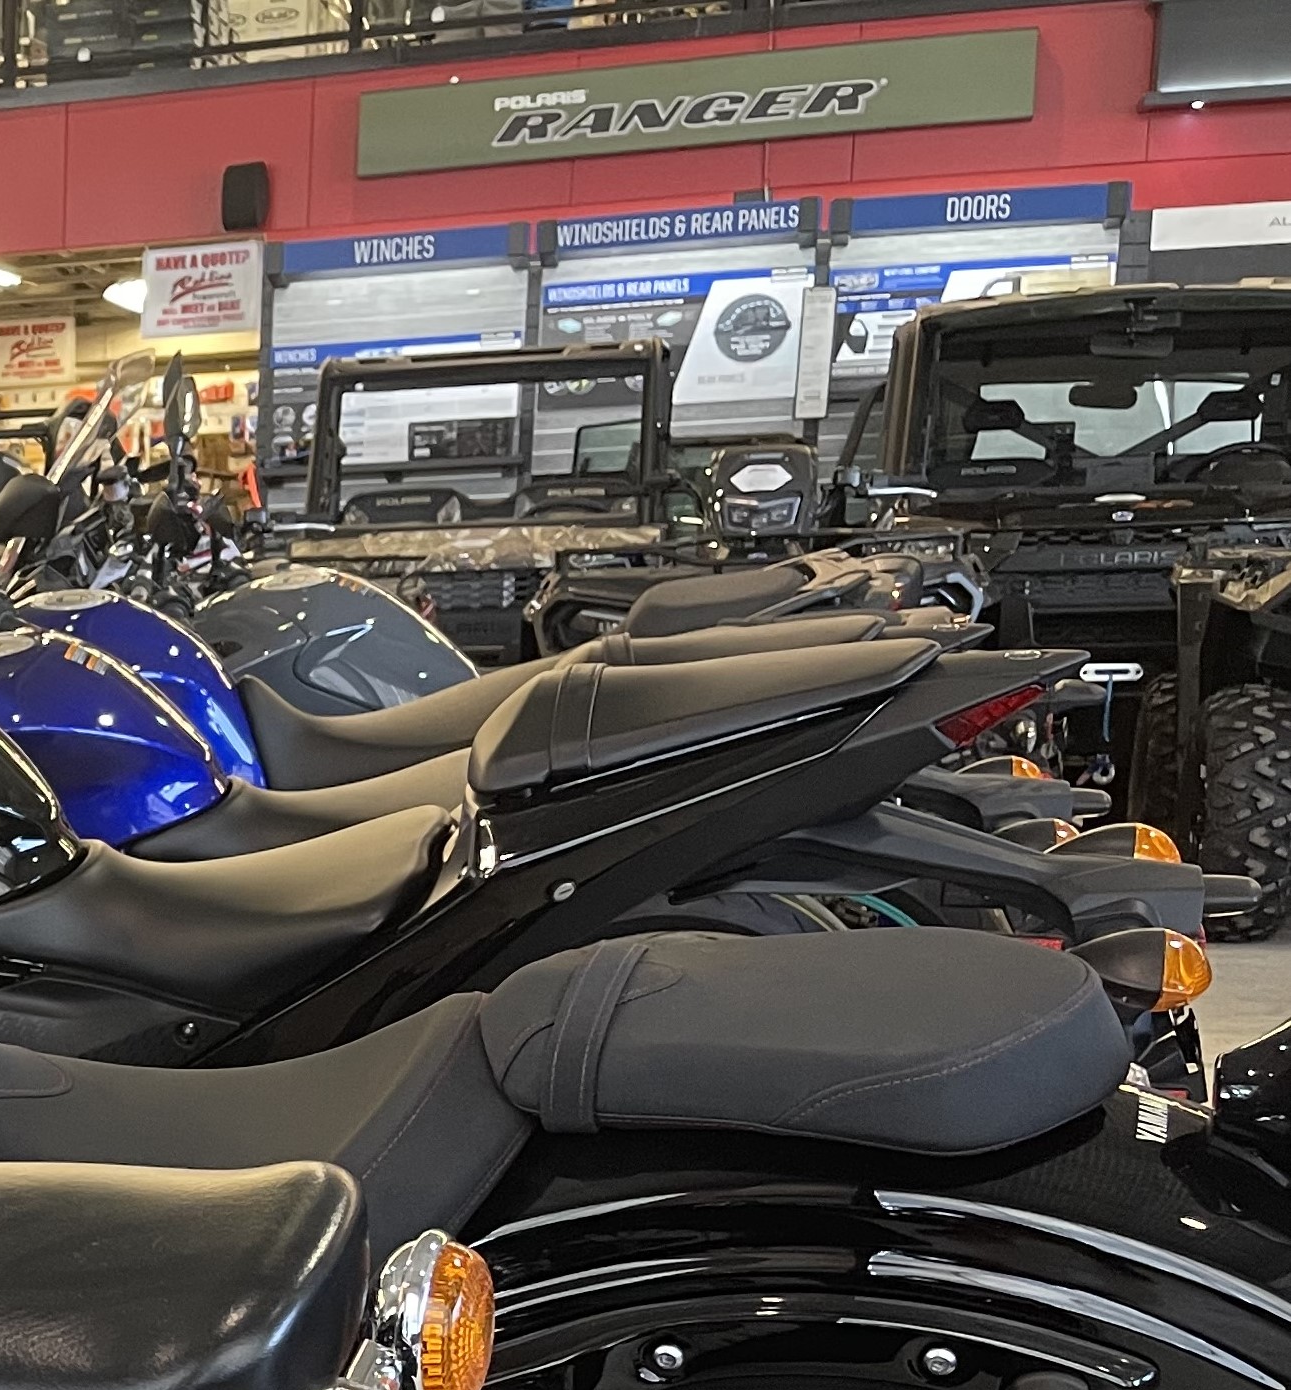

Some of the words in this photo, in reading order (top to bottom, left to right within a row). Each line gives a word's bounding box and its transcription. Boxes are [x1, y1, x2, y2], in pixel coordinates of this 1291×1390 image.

[492, 79, 877, 147] RANGER
[493, 88, 588, 111] POLARIS
[946, 193, 1012, 222] DOORS
[557, 216, 670, 247] WINDSHIELDS
[674, 214, 686, 238] &
[691, 208, 733, 236] REAR
[738, 205, 800, 231] PANELS
[156, 255, 187, 271] HAVE
[190, 254, 198, 268] A
[353, 234, 435, 264] WINCHES
[626, 280, 652, 297] REAR
[653, 278, 690, 294] PANELS
